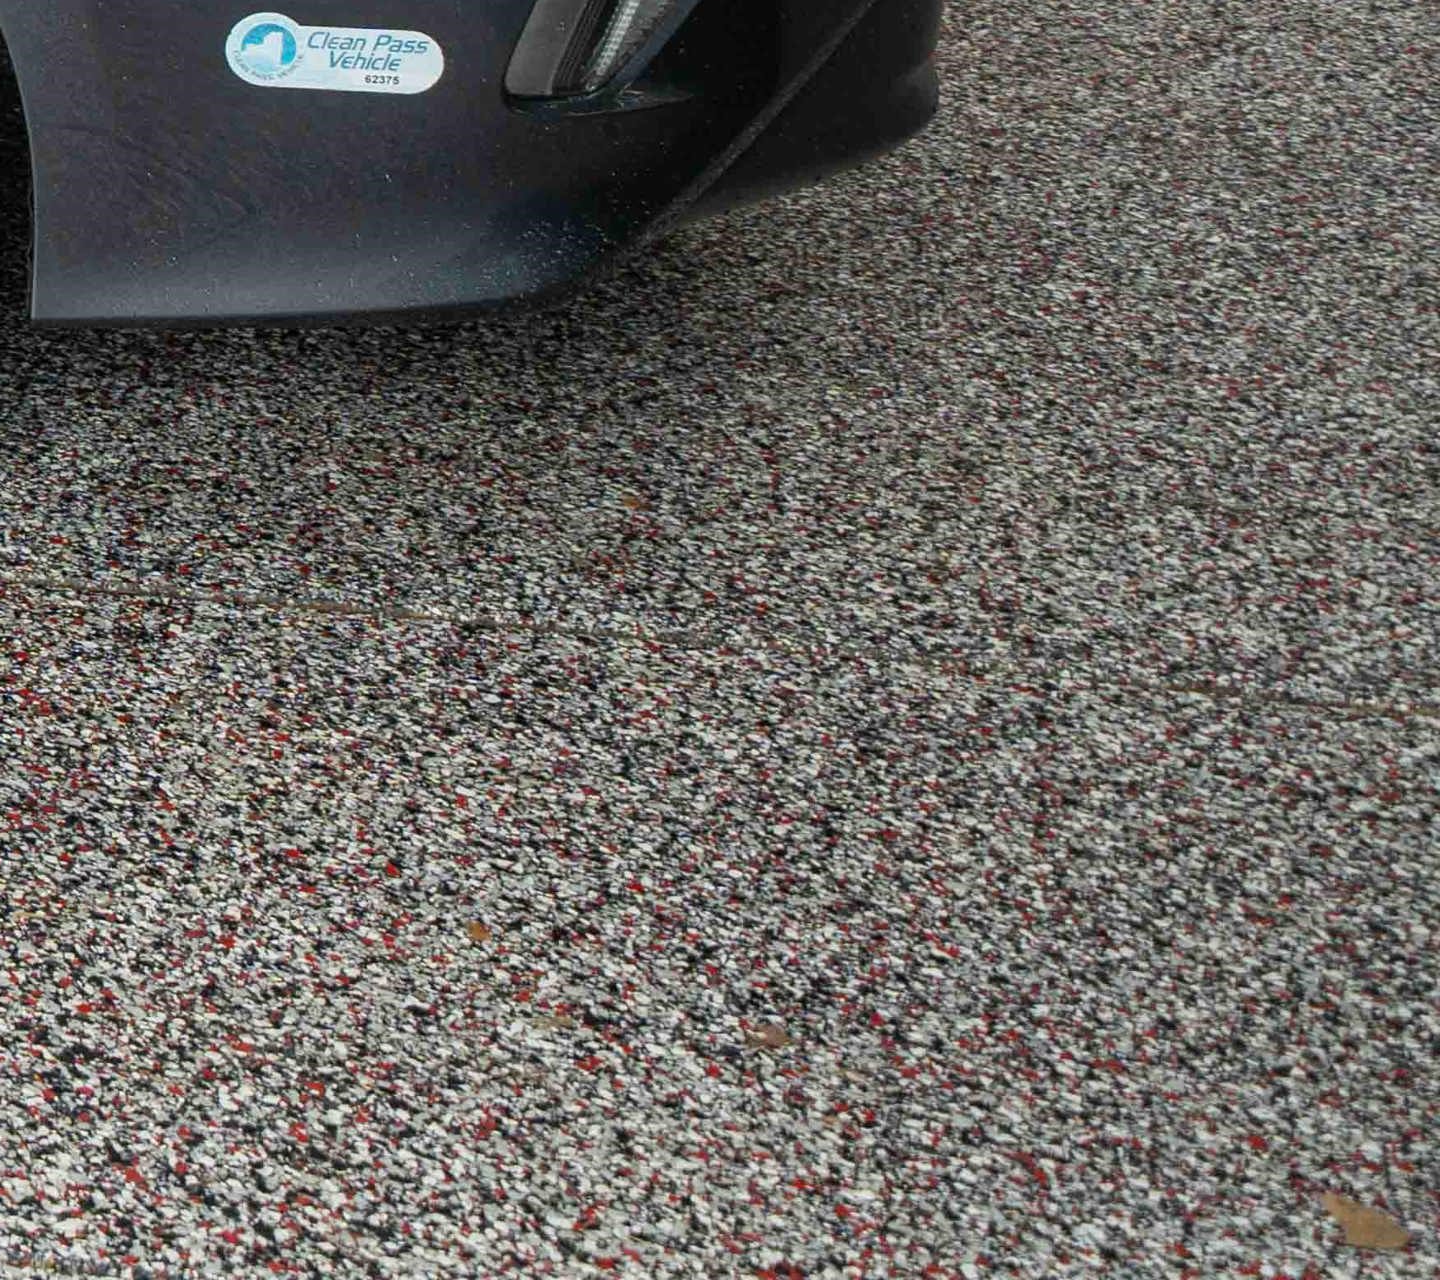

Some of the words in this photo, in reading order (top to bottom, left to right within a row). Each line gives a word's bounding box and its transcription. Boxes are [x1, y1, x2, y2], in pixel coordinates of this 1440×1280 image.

[306, 31, 366, 52] Clean
[373, 35, 430, 54] Pass
[328, 51, 402, 71] Vehicle
[364, 74, 400, 85] 62375
